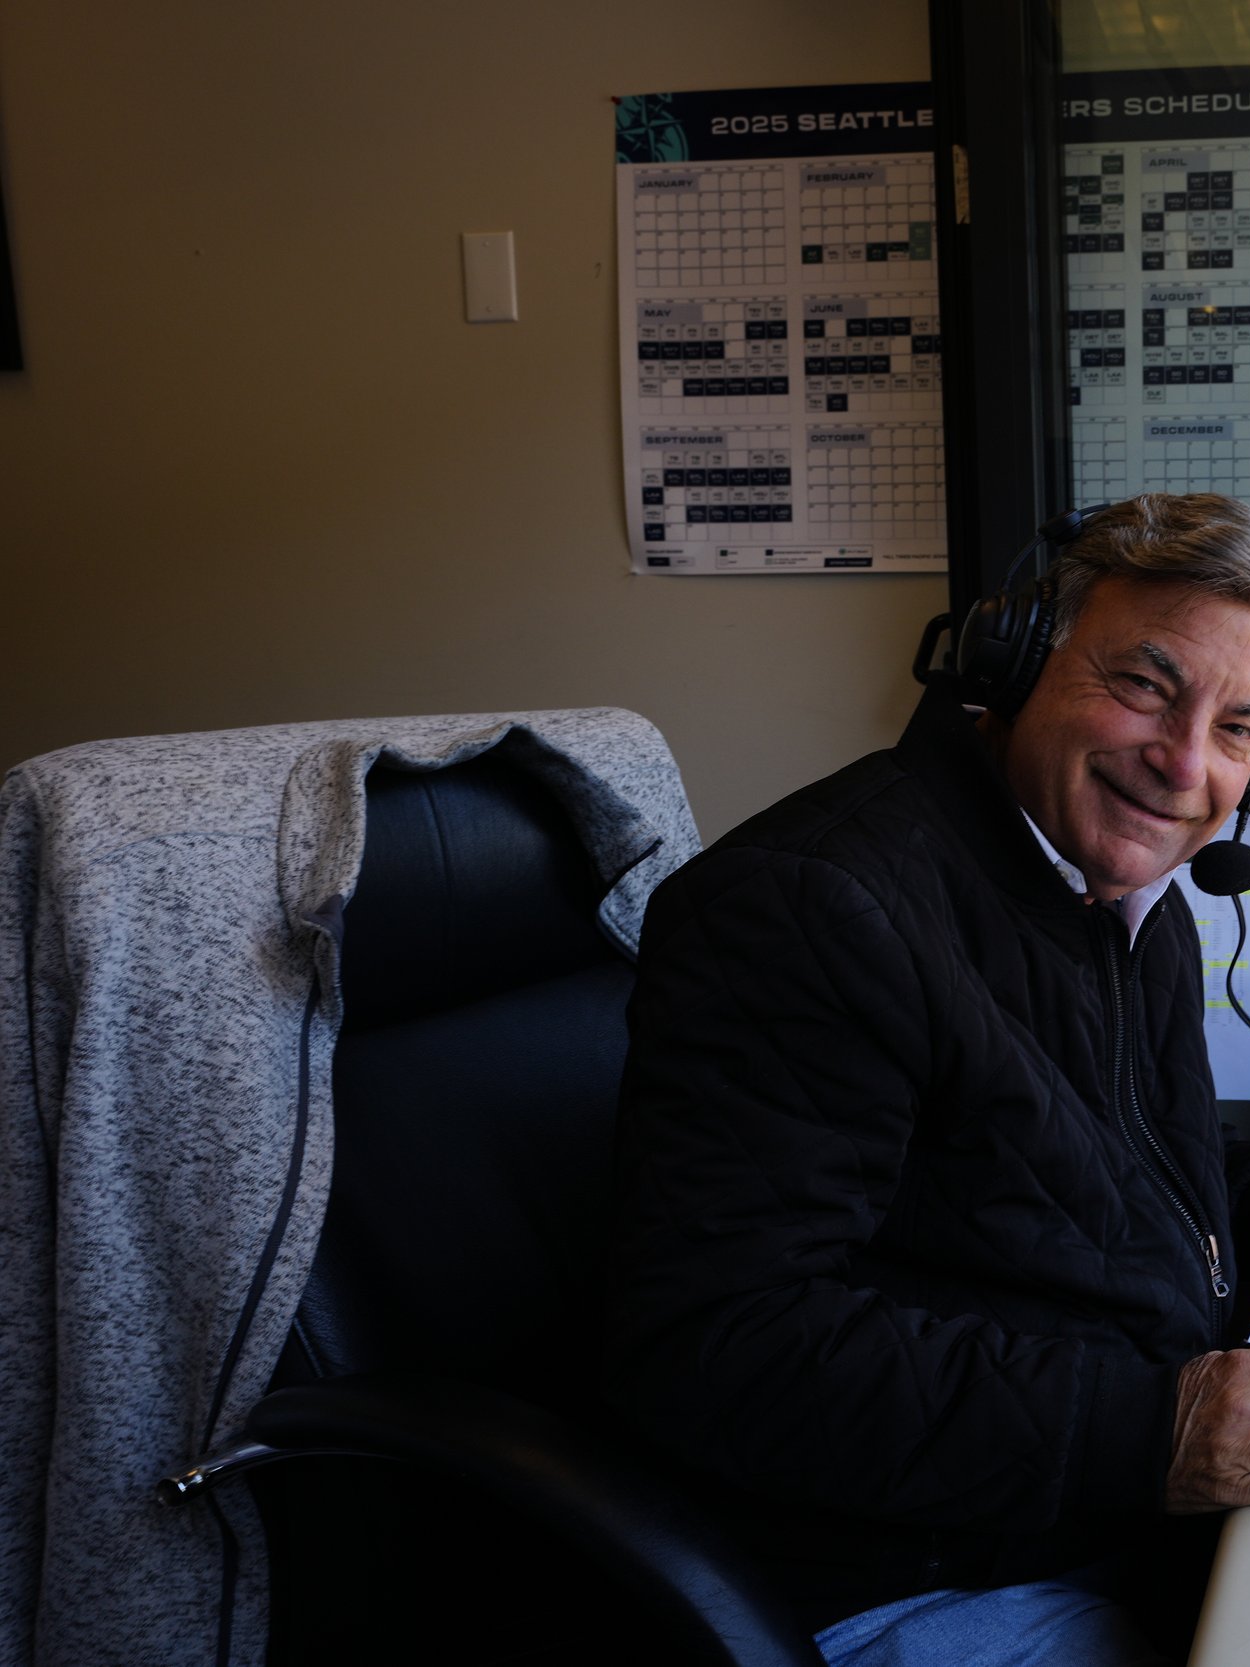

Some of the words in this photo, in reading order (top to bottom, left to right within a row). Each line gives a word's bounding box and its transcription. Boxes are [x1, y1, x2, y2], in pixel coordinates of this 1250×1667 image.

[711, 115, 789, 135] 2025
[798, 109, 935, 131] SEATTLE
[1063, 99, 1113, 118] RS
[1149, 158, 1188, 167] APRIL
[807, 172, 874, 182] FEBRUARY
[639, 179, 694, 189] JANUARY
[1150, 292, 1203, 302] AUGUST
[644, 309, 671, 317] MAY
[810, 304, 843, 313] JUNE
[1151, 425, 1224, 435] DECEMBER
[646, 436, 723, 444] SEPTEMBER
[811, 434, 865, 442] OCTOBER
